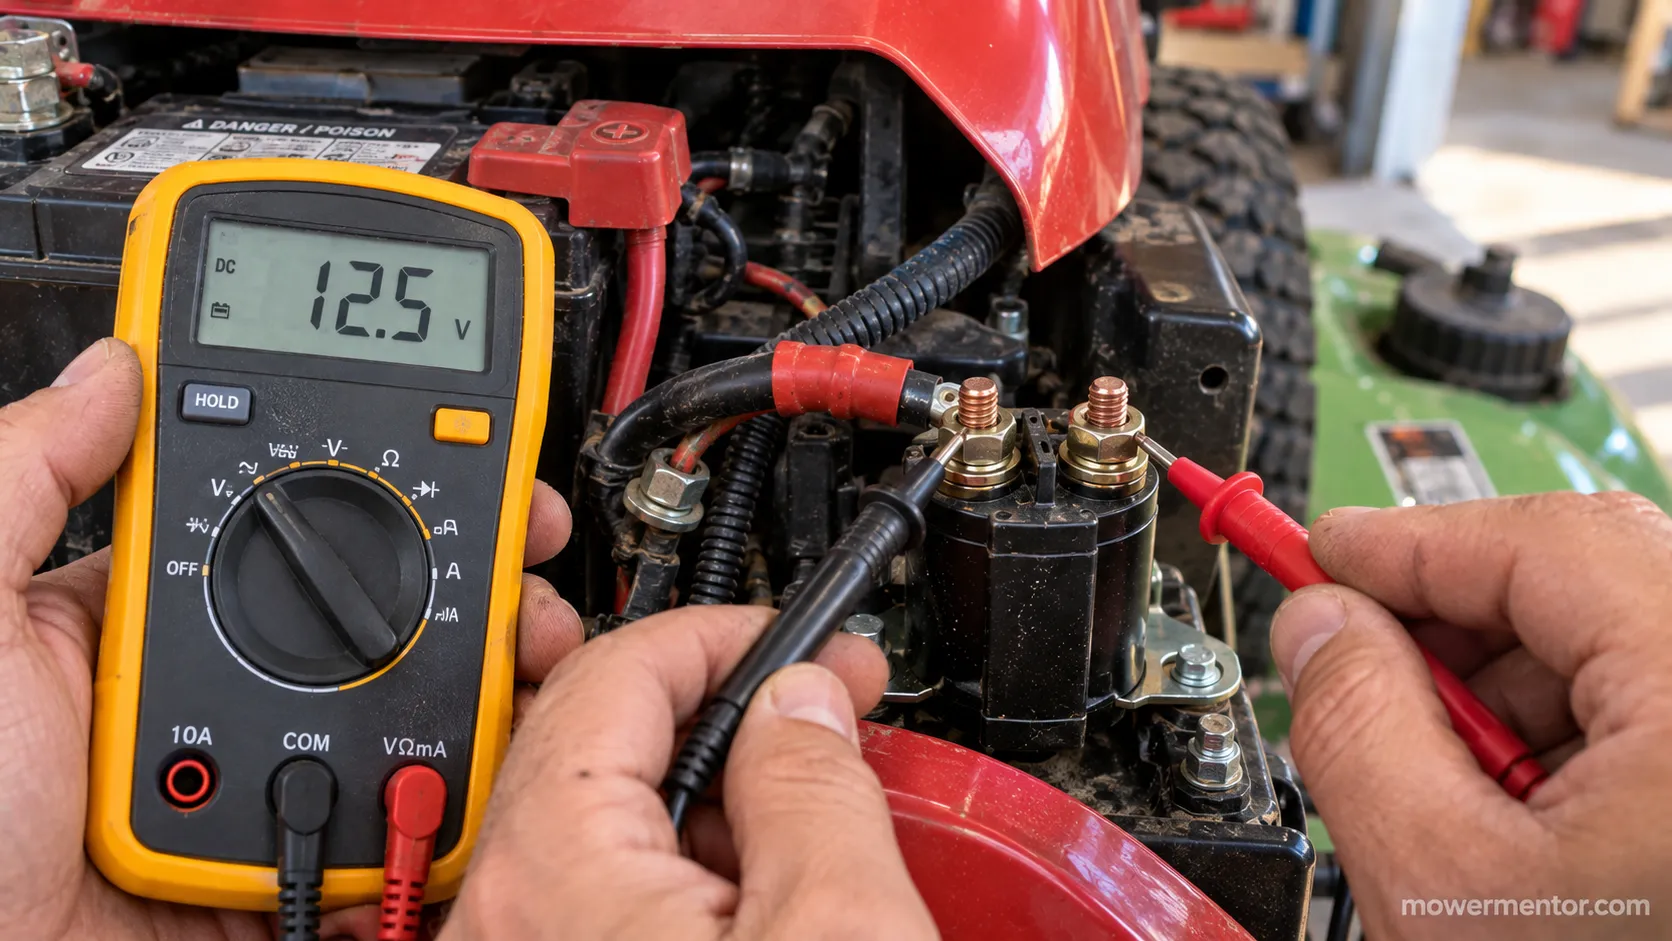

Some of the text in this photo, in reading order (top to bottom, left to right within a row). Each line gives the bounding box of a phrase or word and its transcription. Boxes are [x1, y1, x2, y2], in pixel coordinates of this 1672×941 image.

[208, 120, 297, 134] DANGER
[314, 125, 397, 138] POISON
[215, 257, 236, 275] DC
[310, 260, 472, 343] 12.5 V
[195, 392, 239, 410] HOLD
[381, 449, 400, 468] Ω
[166, 561, 198, 577] OFF
[445, 562, 461, 580] A
[171, 725, 213, 746] 10A
[283, 732, 330, 752] COM
[383, 737, 448, 758] VΩmA
